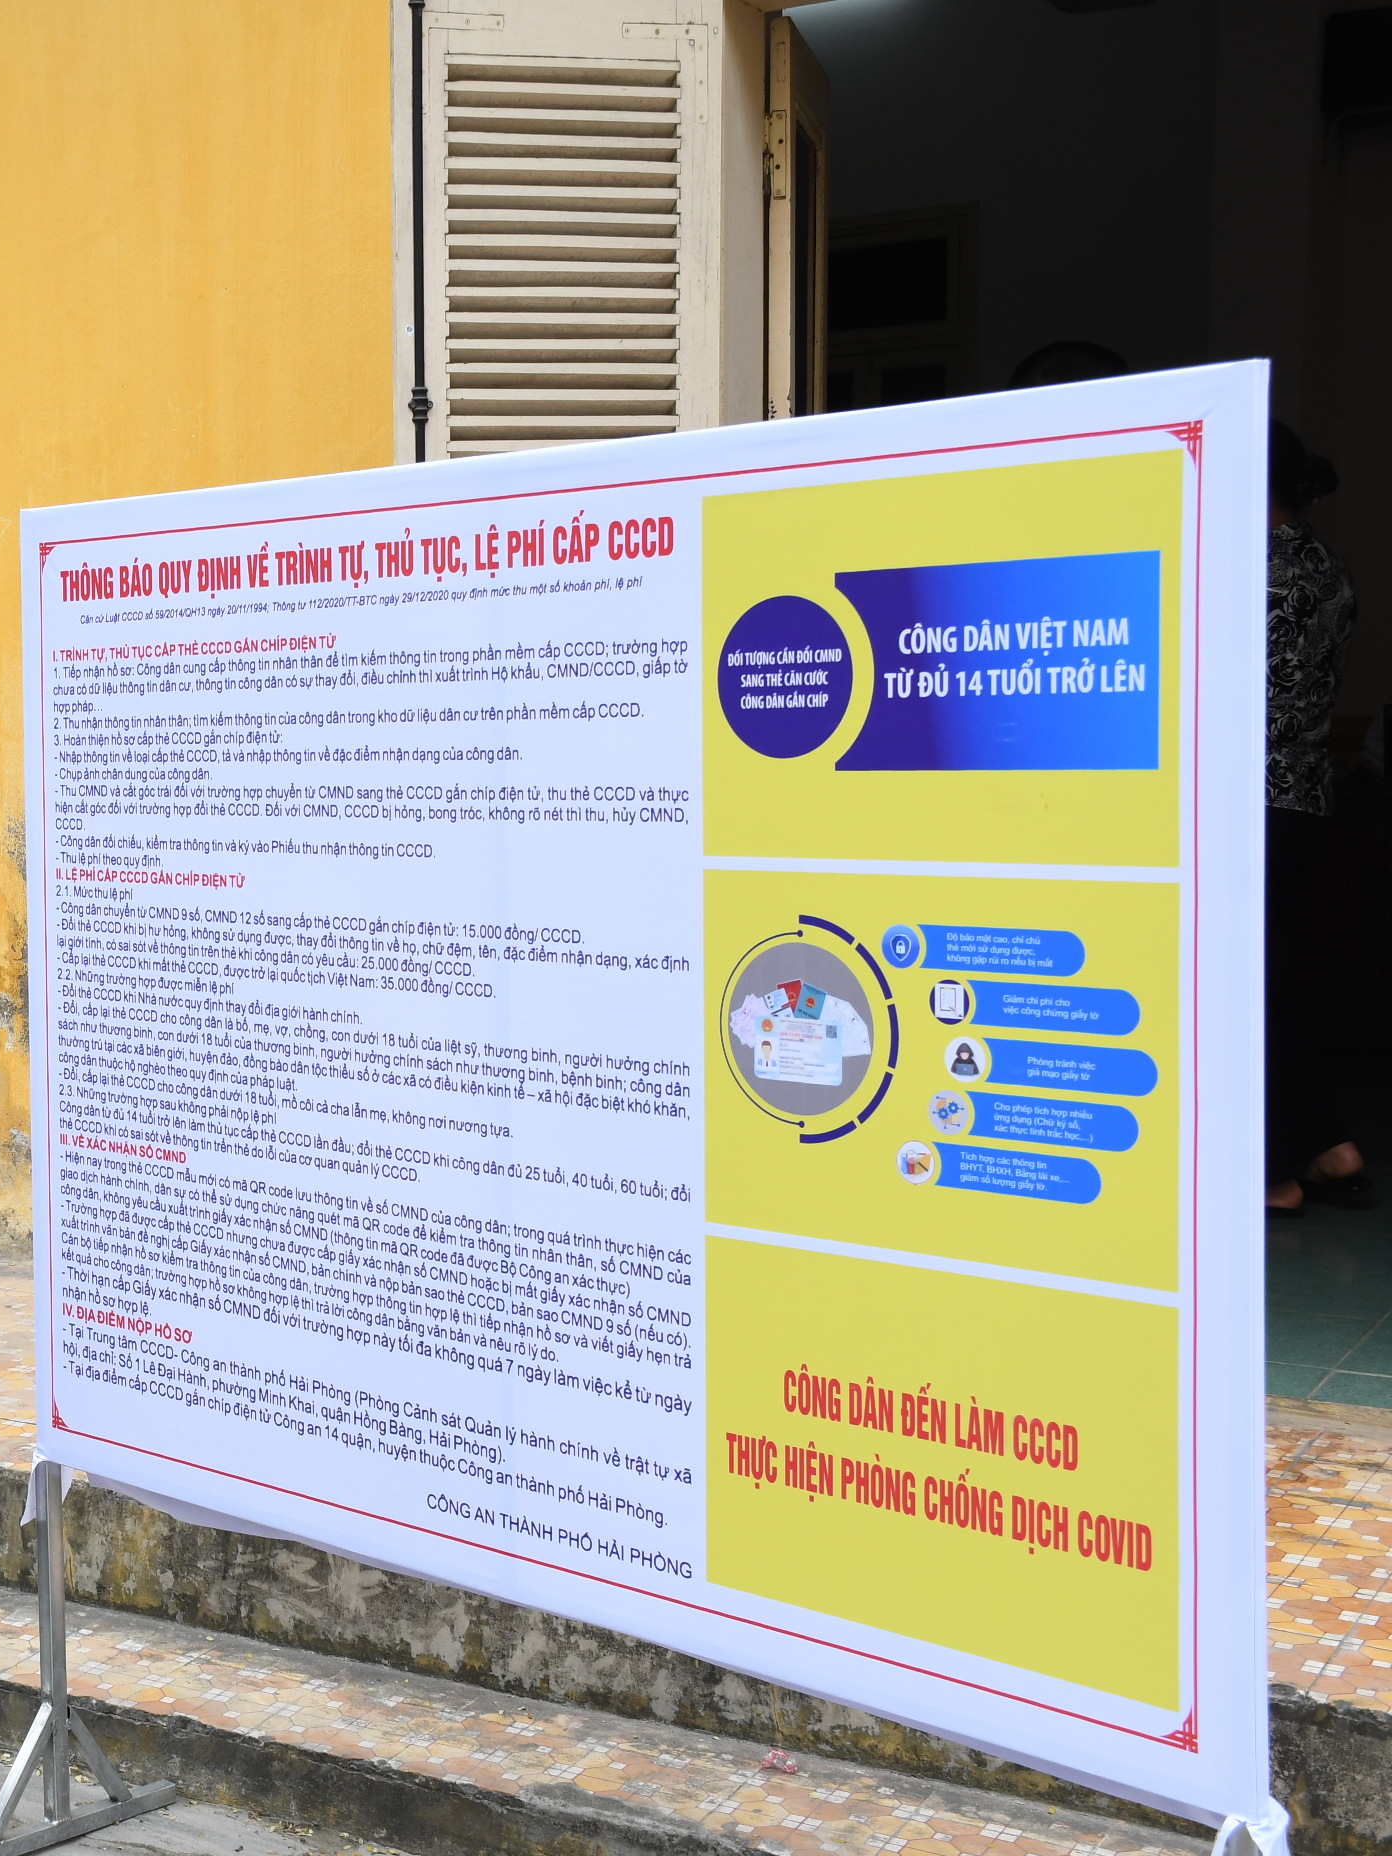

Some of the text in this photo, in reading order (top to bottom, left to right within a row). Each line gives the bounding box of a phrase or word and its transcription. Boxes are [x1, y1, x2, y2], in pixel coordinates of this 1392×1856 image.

[60, 509, 674, 602] THÔNG BÁO QUY ĐỊNH VỀ TRÌNH TỰ, THỦ TỤC, LỆ PHÍ CẤP CCCD
[898, 616, 1129, 656] CÔNG DÂN VIỆT NAM
[727, 649, 743, 667] ĐỐI
[744, 650, 775, 669] TƯỢNG
[796, 645, 813, 664] ĐỔI
[814, 648, 842, 663] CMND
[740, 673, 764, 688] SANG
[765, 669, 783, 687] THẺ
[804, 669, 828, 686] CƯỚC
[883, 657, 1145, 699] TỪ ĐỦ 14 TUỔI TRỞ LÊN
[53, 700, 103, 715] hợp pháp...
[740, 690, 829, 709] CÔNG DÂN GẮN CHÍP
[56, 884, 133, 903] 2.1. Mức thu lệ phí
[57, 967, 234, 997] 2.2. Những trường hợp được miễn lệ phí
[784, 1363, 1078, 1471] CÔNG DÂN ĐẾN LÀM CCCD
[726, 1432, 1152, 1571] THỰC HIỆN PHÒNG CHỐNG DỊCH COVID
[427, 1493, 692, 1579] CÔNG AN THÀNH PHỐ HẢI PHÒNG
